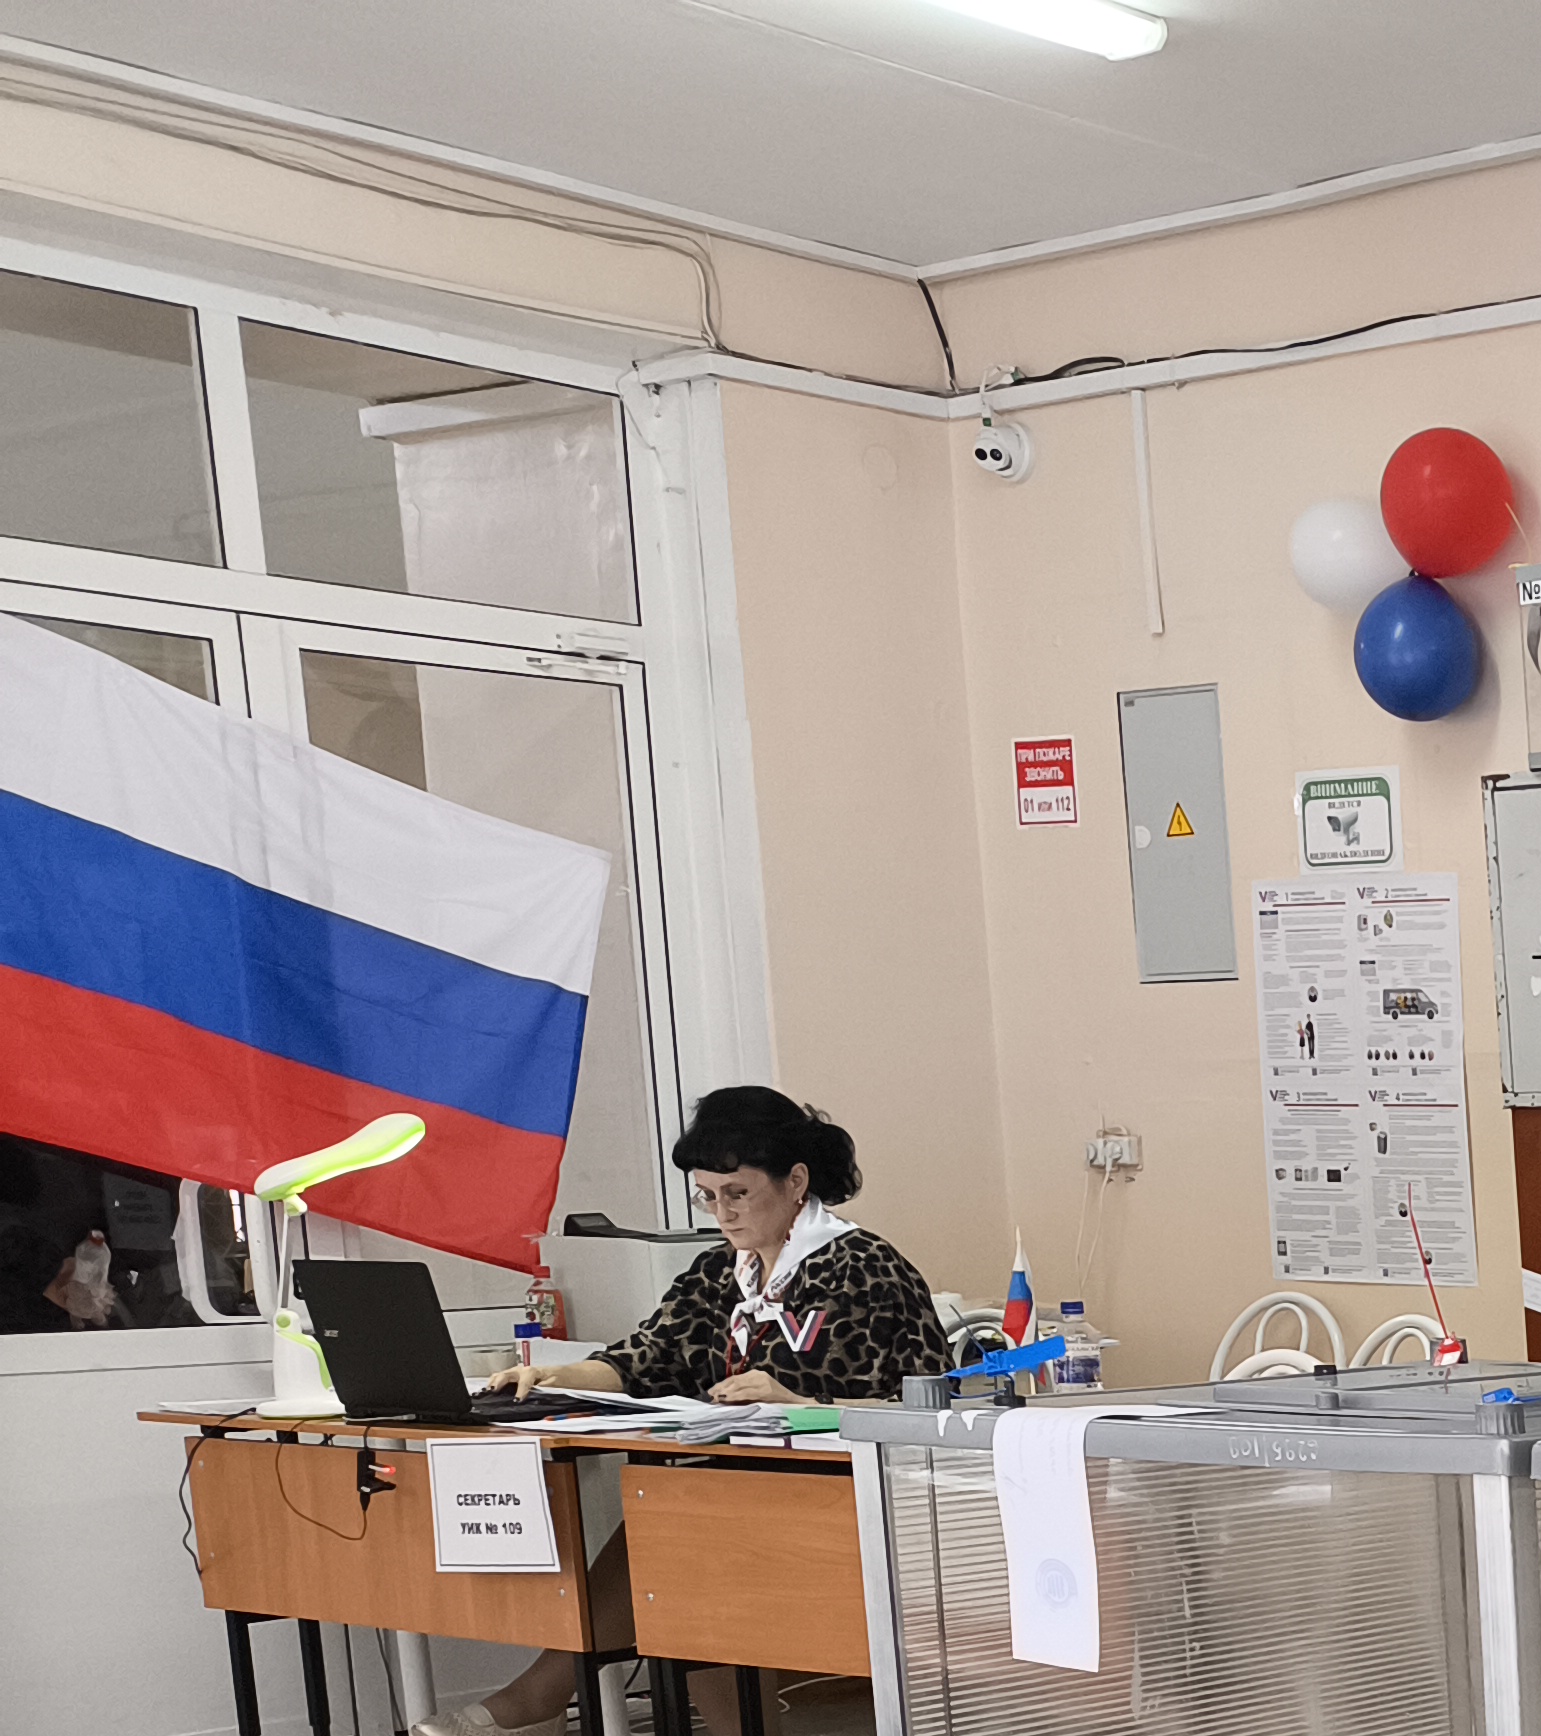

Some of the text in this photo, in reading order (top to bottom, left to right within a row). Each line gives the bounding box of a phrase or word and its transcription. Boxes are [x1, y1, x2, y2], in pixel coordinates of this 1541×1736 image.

[1310, 781, 1380, 797] ВНИМАНИЕ
[1023, 798, 1034, 813] 01
[1056, 796, 1071, 811] 112
[456, 1493, 521, 1506] СЕКРЕТАРЬ
[460, 1522, 523, 1535] УИК № 109
